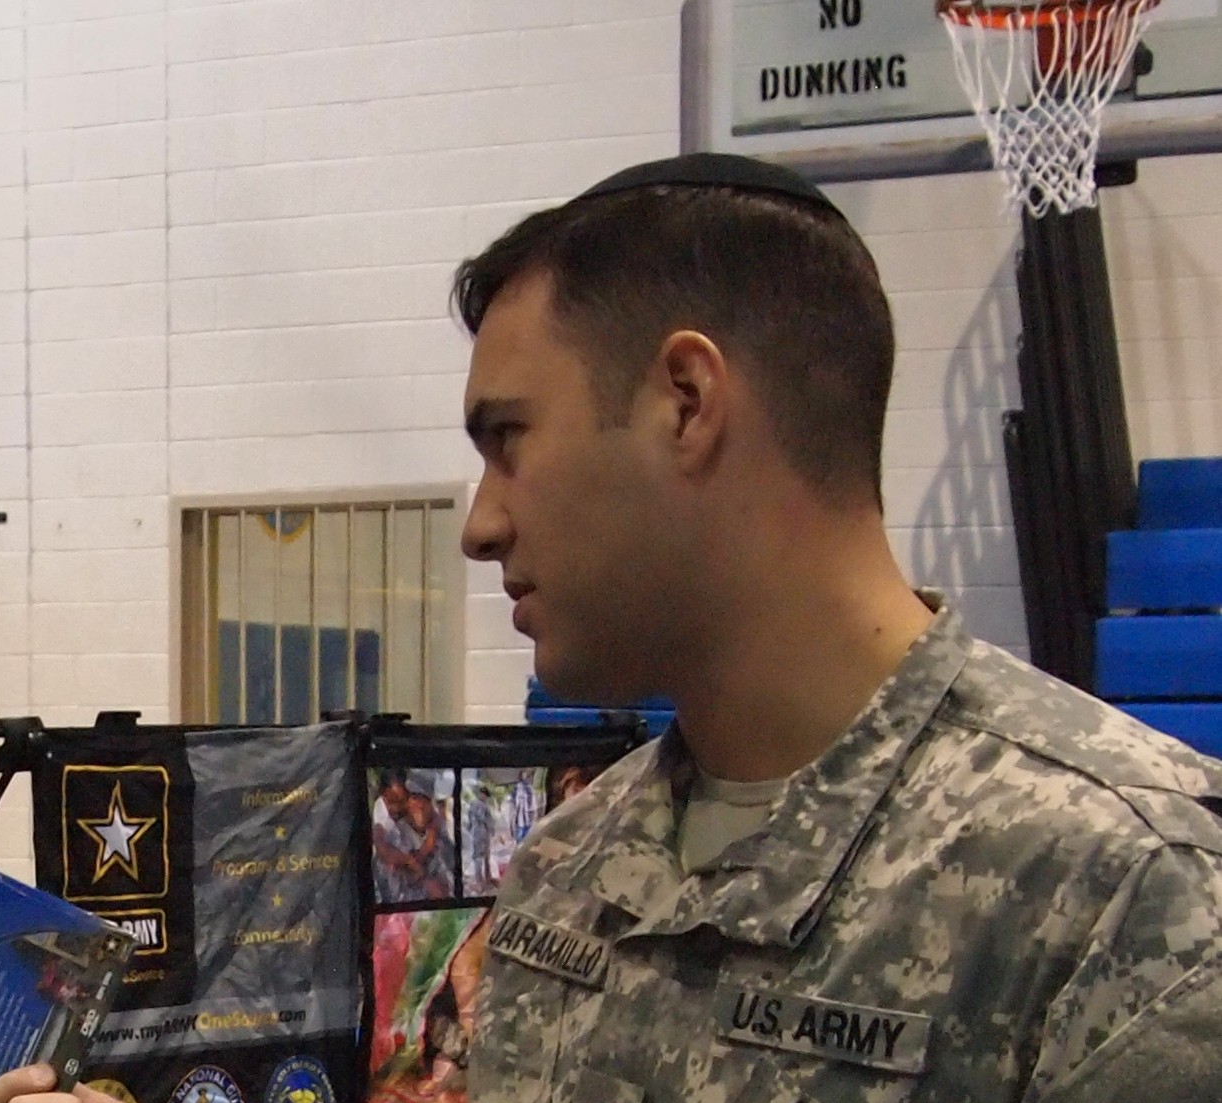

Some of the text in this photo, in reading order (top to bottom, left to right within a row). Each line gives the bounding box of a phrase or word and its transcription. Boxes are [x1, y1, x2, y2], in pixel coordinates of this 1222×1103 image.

[819, 0, 862, 30] NO
[760, 54, 908, 101] DUNKING
[490, 914, 604, 977] JARAMILLO
[732, 992, 907, 1058] U.S. ARMY
